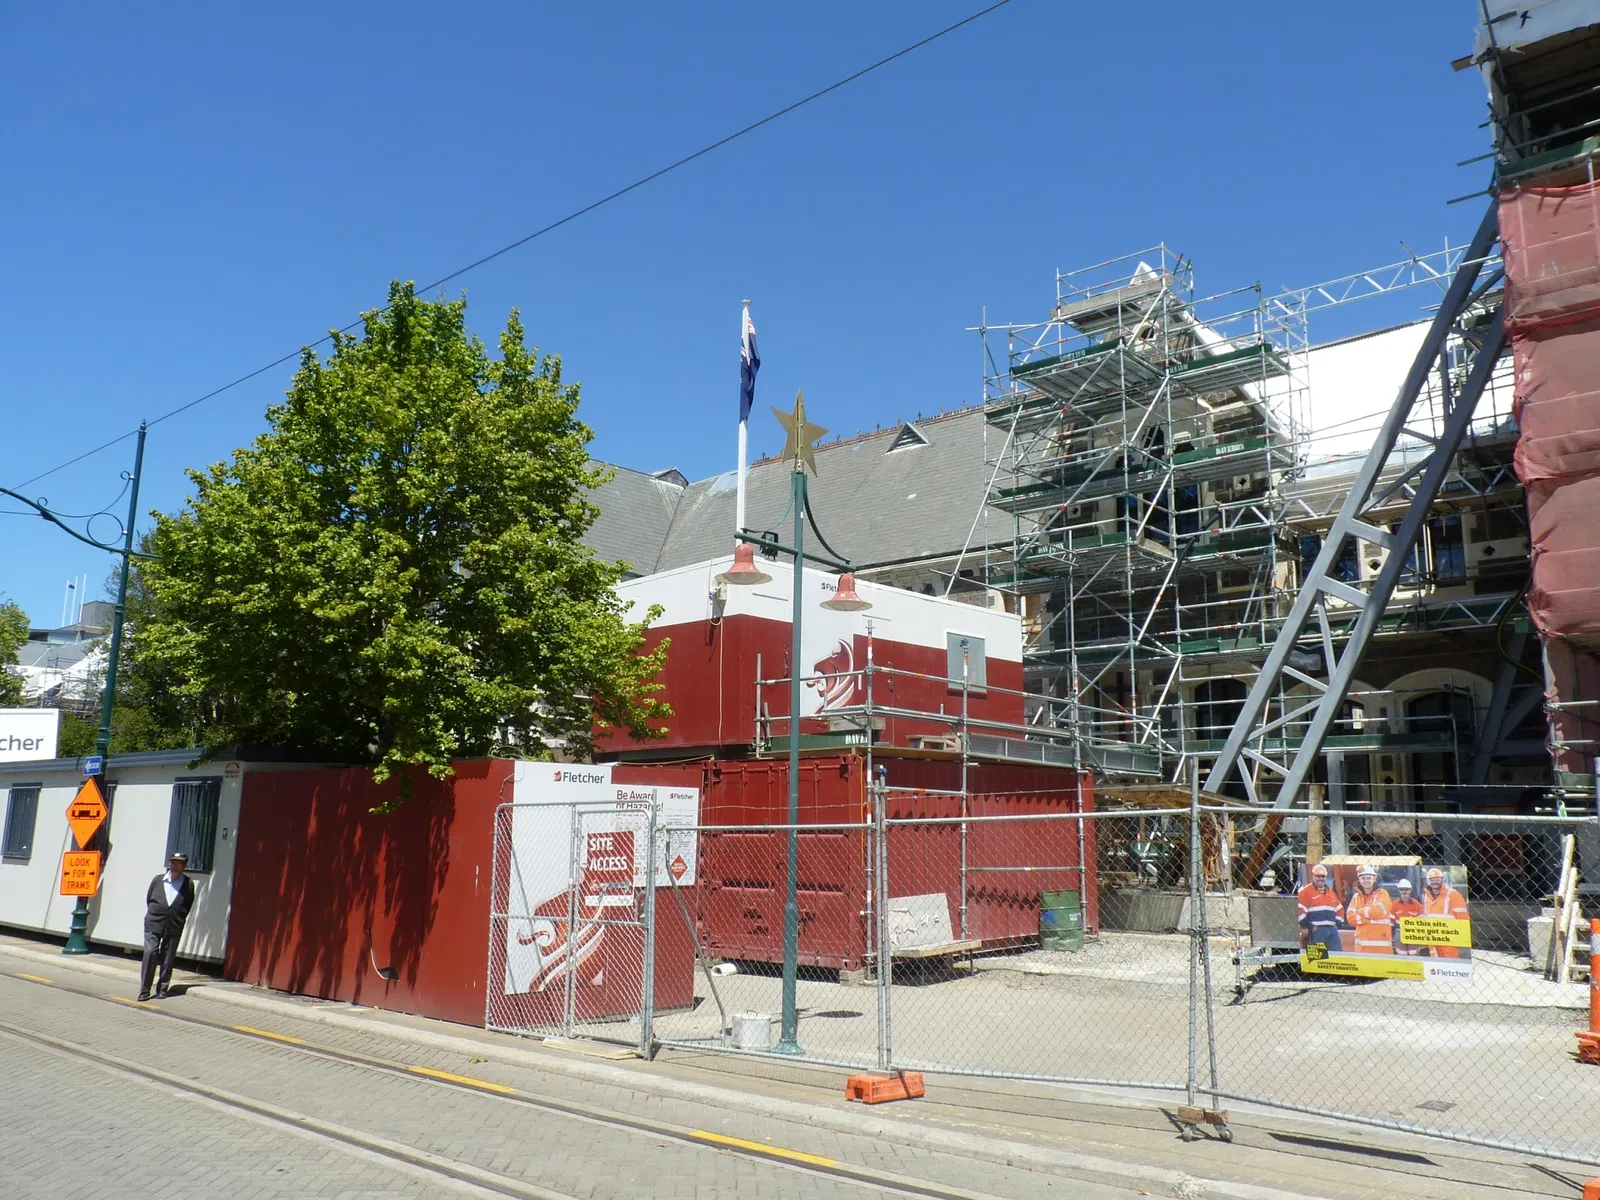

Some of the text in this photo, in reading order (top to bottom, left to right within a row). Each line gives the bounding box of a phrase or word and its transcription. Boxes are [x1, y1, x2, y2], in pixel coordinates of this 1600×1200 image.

[562, 771, 605, 784] Fletcher
[616, 789, 628, 800] Be
[626, 802, 664, 812] Hazars!
[589, 837, 613, 851] SITE
[70, 858, 91, 867] LOOK
[589, 856, 628, 871] ACCESS
[72, 869, 86, 878] FOR
[67, 880, 90, 890] TRAMS
[1427, 928, 1440, 936] got
[1436, 969, 1470, 978] Fletcher
